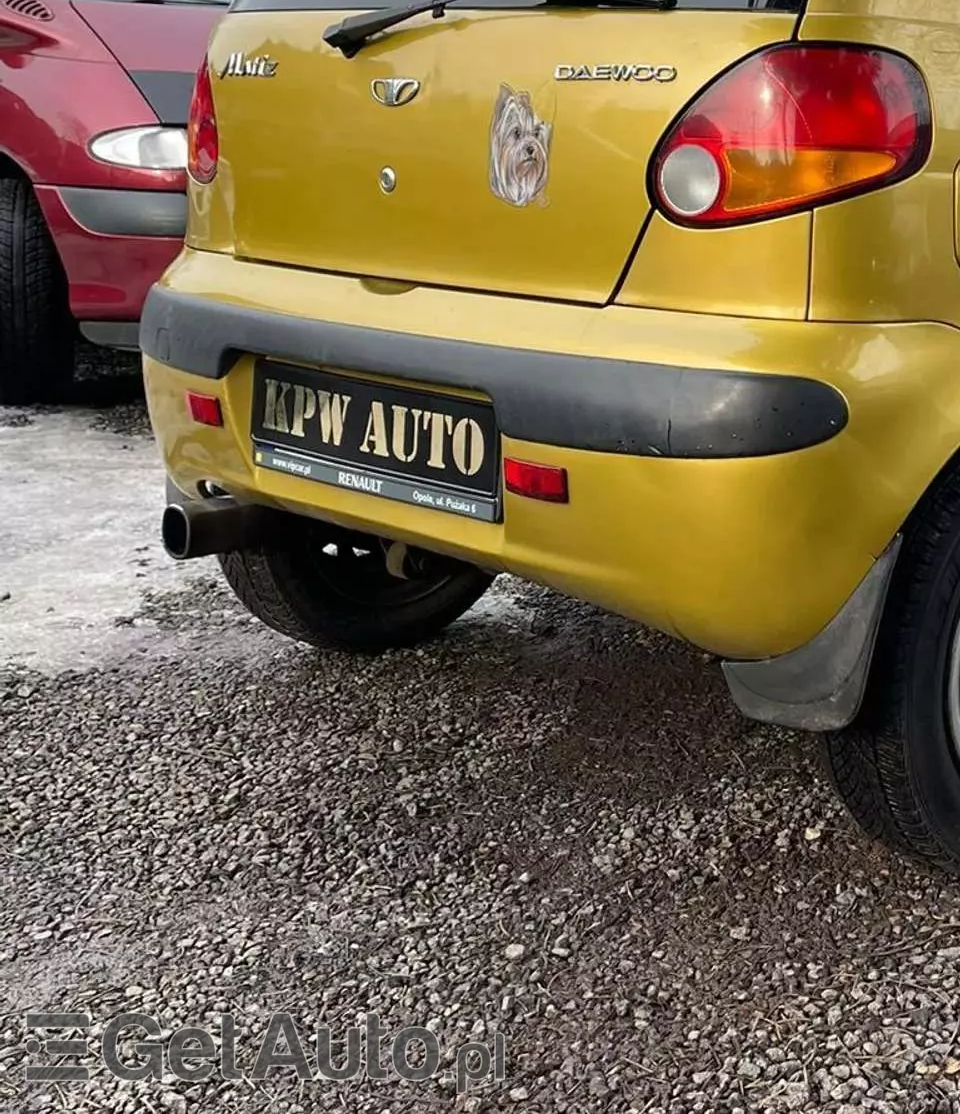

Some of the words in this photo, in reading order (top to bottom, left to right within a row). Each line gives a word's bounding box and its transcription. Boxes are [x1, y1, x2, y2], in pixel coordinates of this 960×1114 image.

[217, 52, 278, 79] Matiz
[554, 63, 677, 82] DAEWOO
[262, 378, 351, 446] KPW
[359, 401, 485, 476] AUTO
[338, 471, 383, 493] RENAULT
